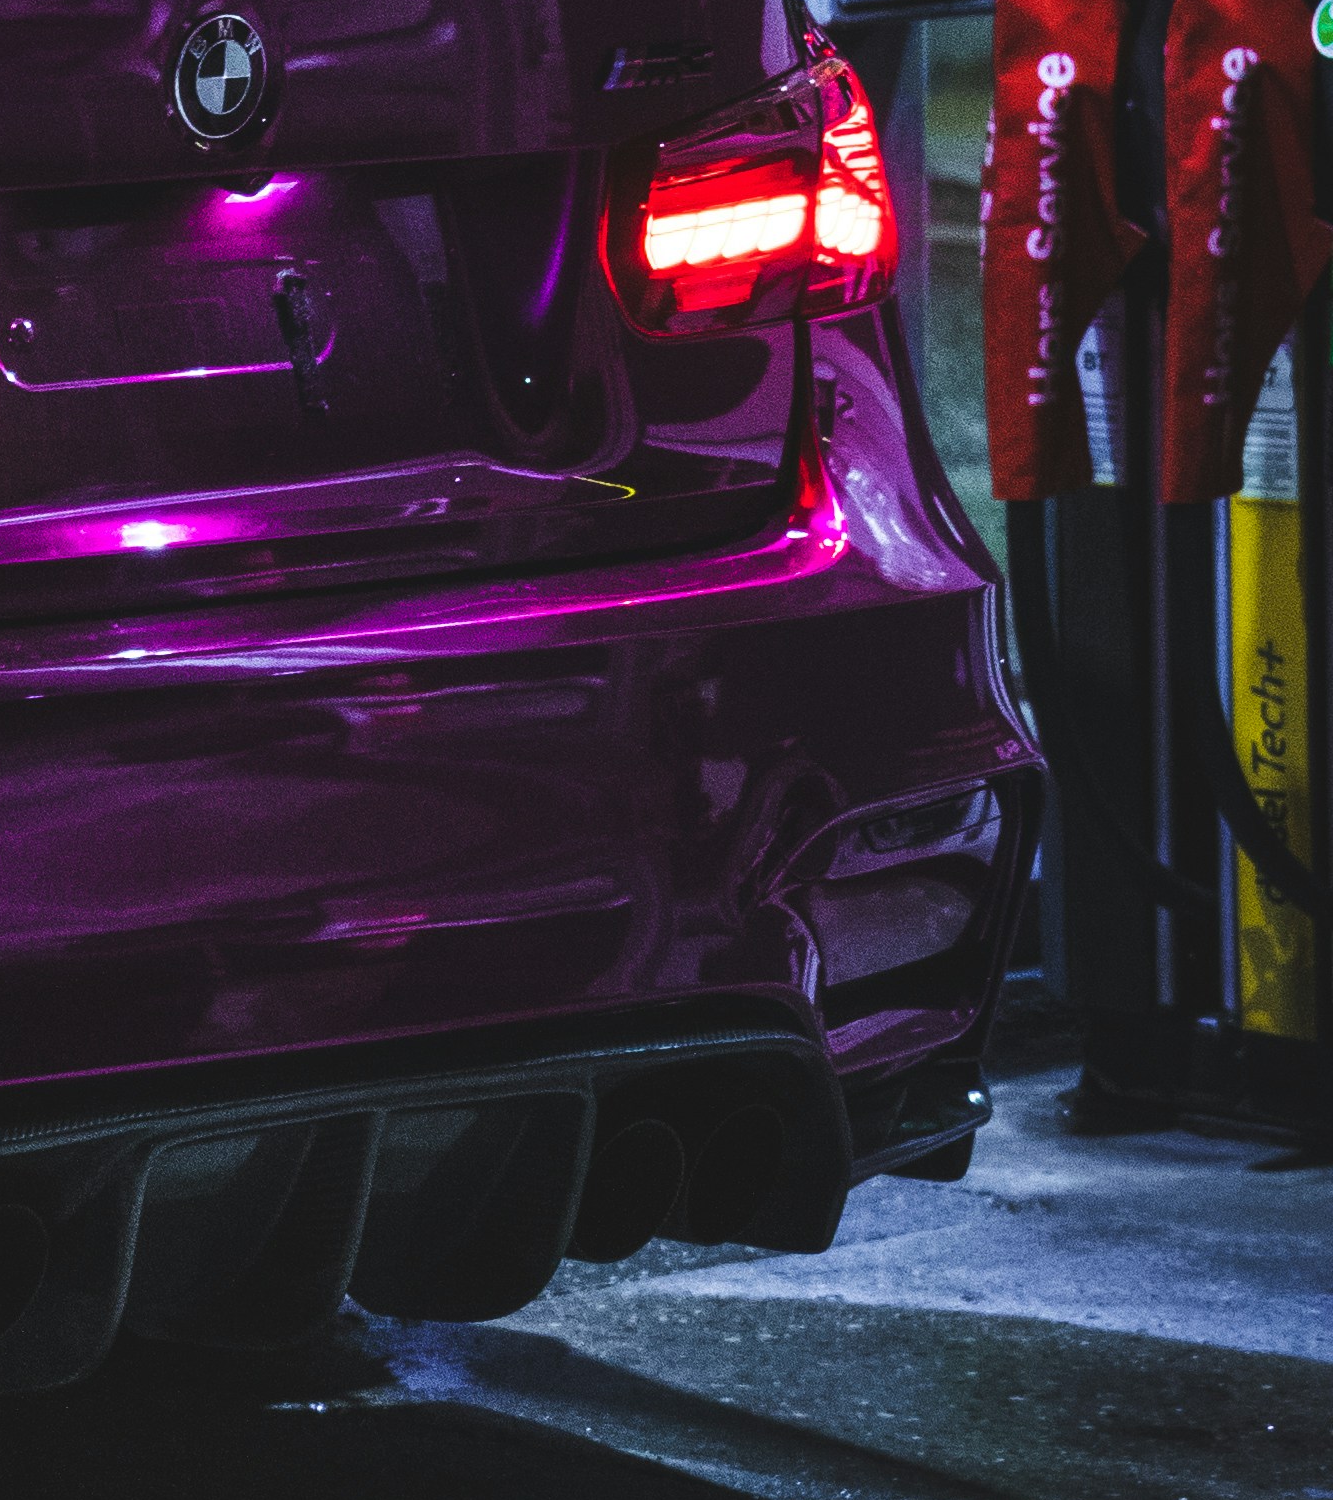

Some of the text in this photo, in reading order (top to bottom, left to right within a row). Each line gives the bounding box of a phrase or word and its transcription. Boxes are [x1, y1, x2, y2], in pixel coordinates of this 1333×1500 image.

[188, 18, 264, 60] BMW
[1026, 51, 1077, 407] Hors Service
[1207, 46, 1260, 260] Service
[1249, 640, 1287, 775] Tech+
